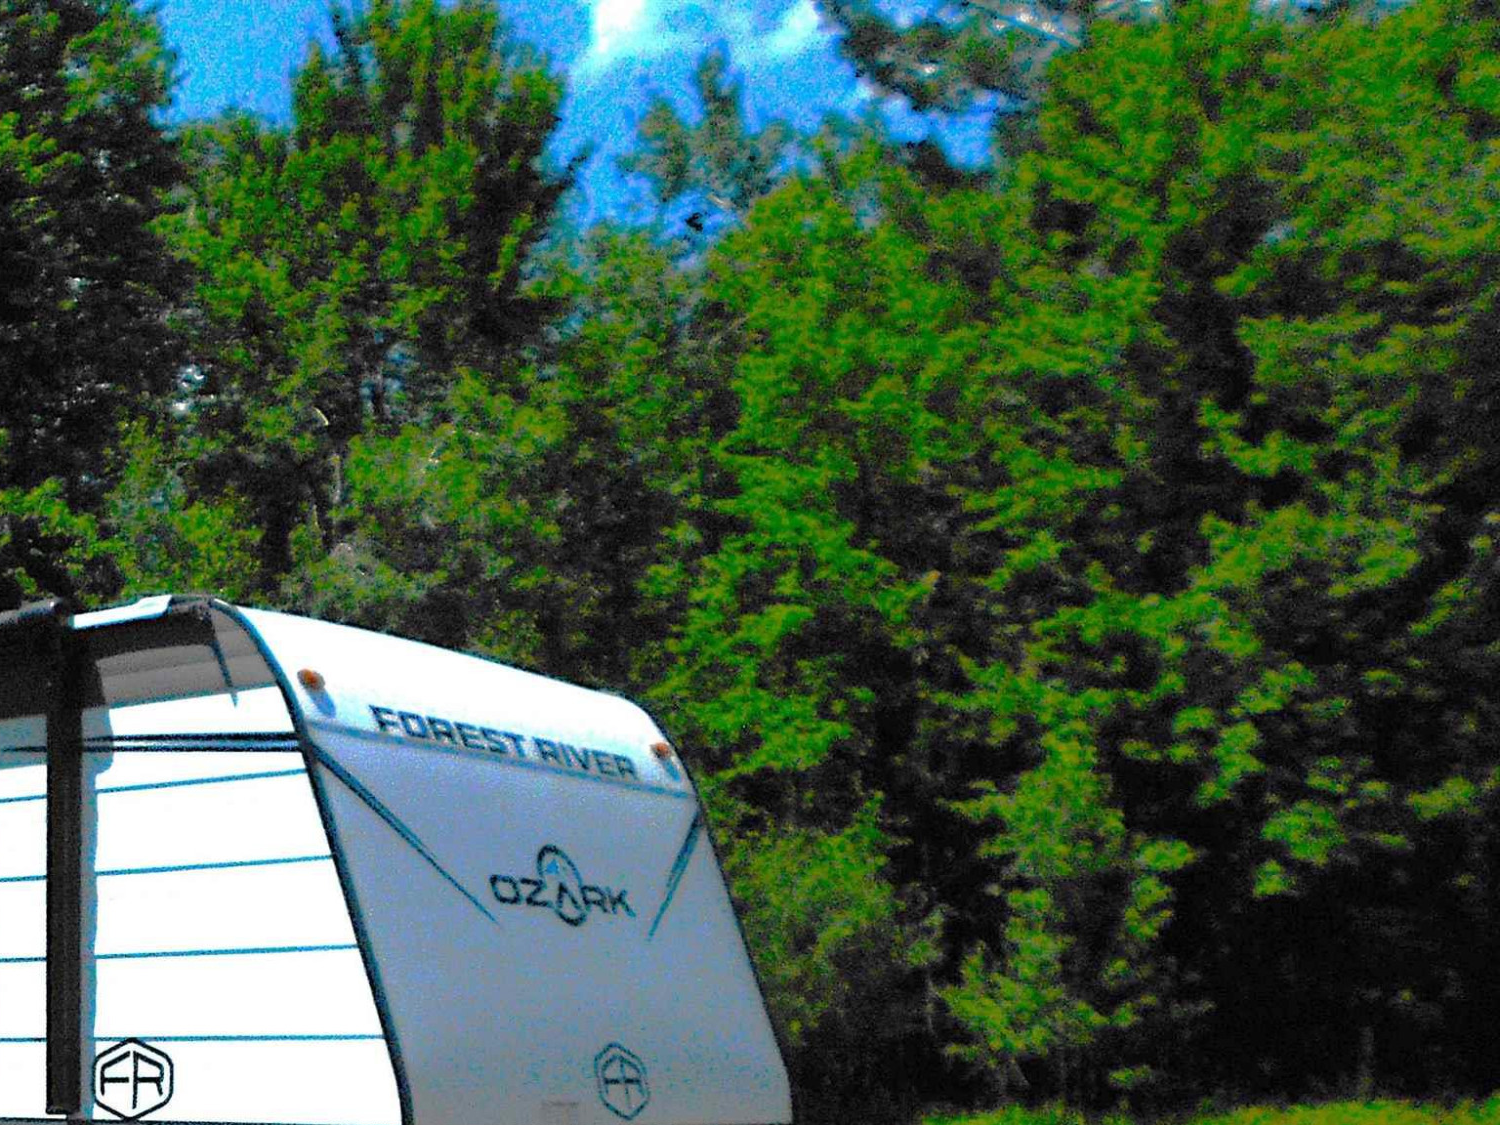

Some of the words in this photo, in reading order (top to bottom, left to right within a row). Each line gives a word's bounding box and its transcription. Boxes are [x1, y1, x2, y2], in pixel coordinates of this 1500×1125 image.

[368, 704, 528, 758] FOREST
[532, 735, 639, 781] RIVER
[489, 873, 637, 918] OZARK
[100, 1050, 164, 1110] FR
